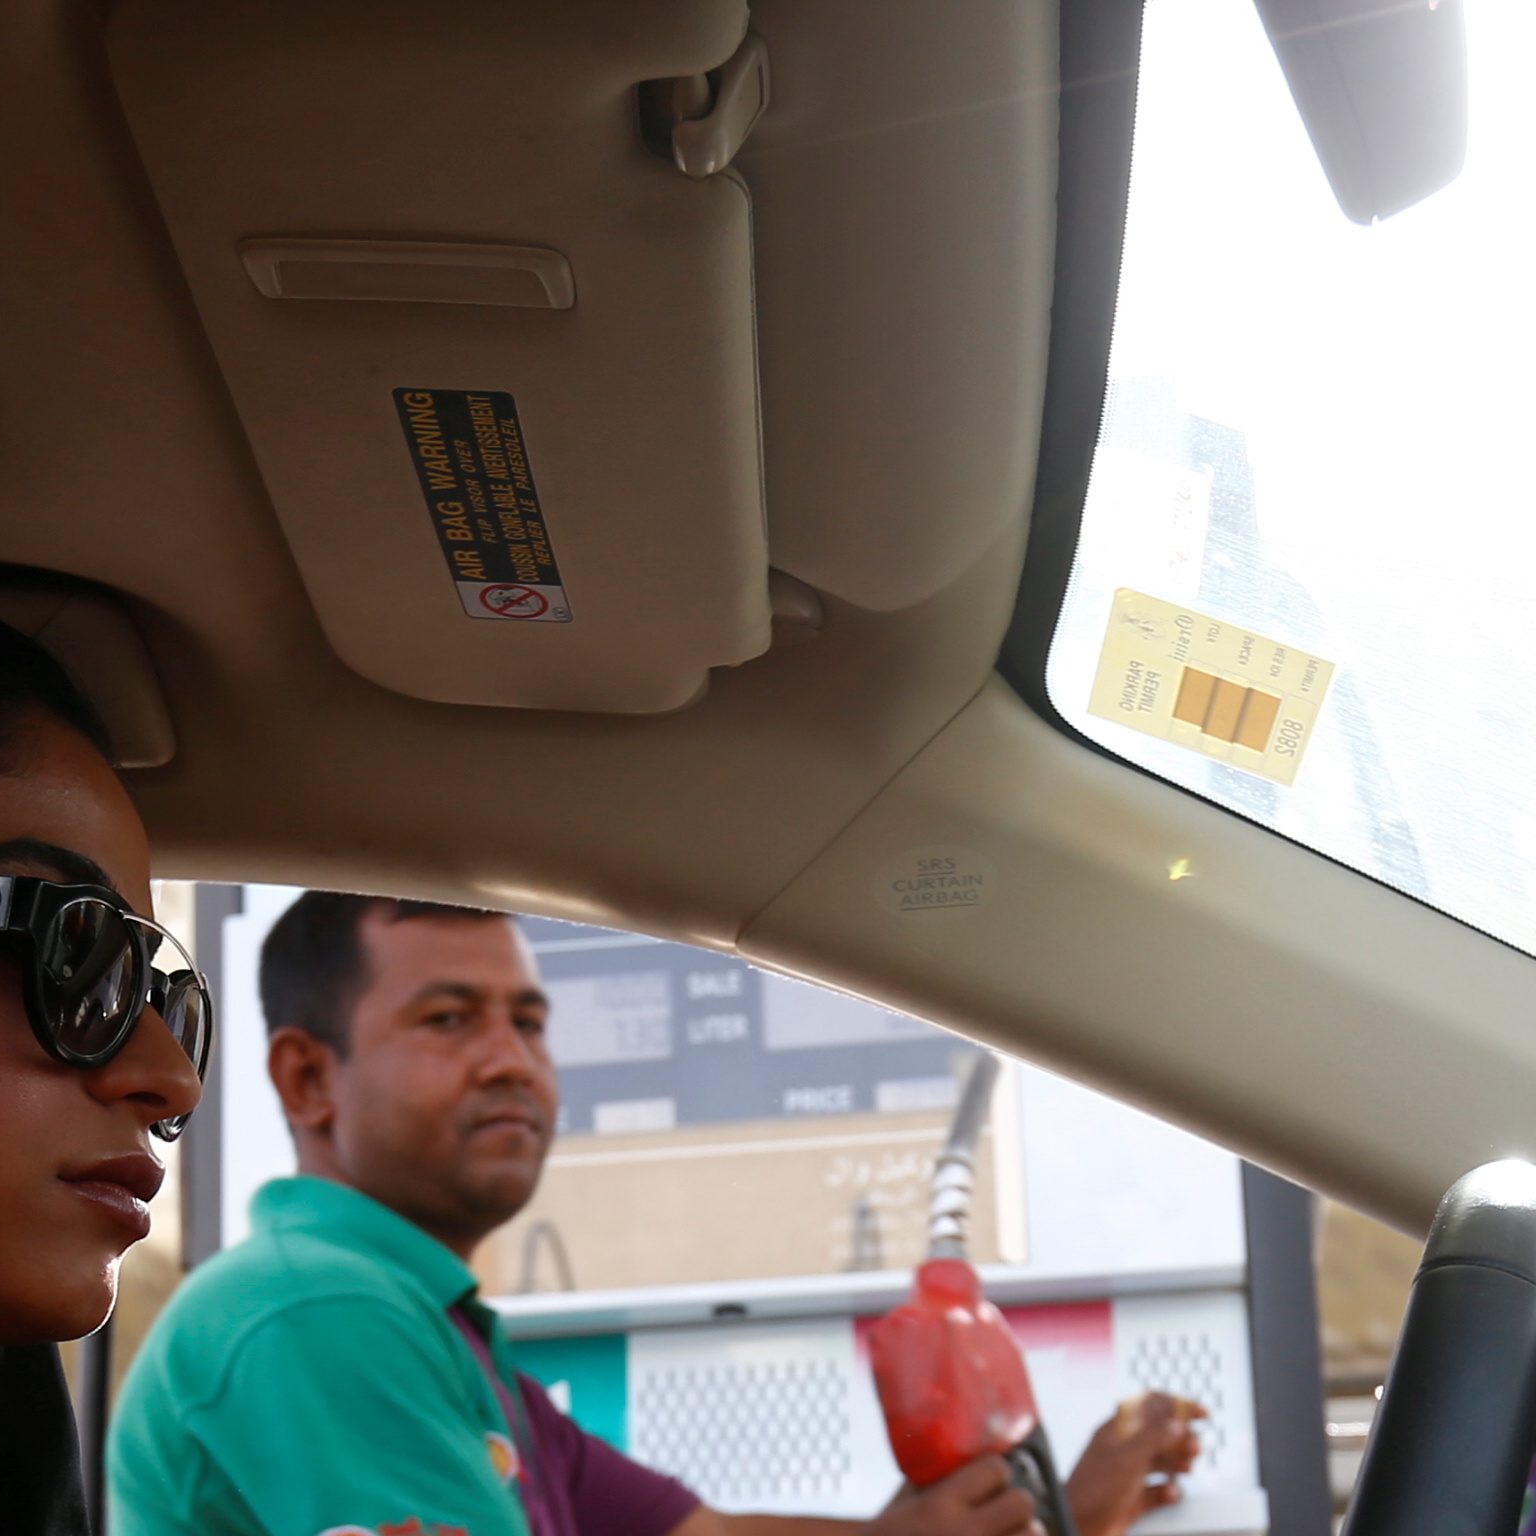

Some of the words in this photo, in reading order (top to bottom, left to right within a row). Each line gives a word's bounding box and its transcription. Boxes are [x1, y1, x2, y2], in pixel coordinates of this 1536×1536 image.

[404, 392, 458, 491] WARNING
[466, 395, 510, 480] AVERTISSEMENT
[500, 418, 532, 490] PARESOLEIL
[454, 440, 476, 473] OVER
[469, 479, 488, 513] VISOR
[490, 484, 526, 540] GONFLABLE
[521, 499, 539, 513] LE
[437, 501, 474, 541] BAG
[478, 519, 497, 544] FLIP
[528, 521, 552, 566] REPLIER
[451, 549, 487, 580] AIR
[511, 544, 541, 582] COUSSIN
[917, 857, 957, 872] SRS
[892, 874, 984, 893] CURTAIN
[900, 889, 980, 906] AIRBAG
[784, 1085, 852, 1112] PRICE
